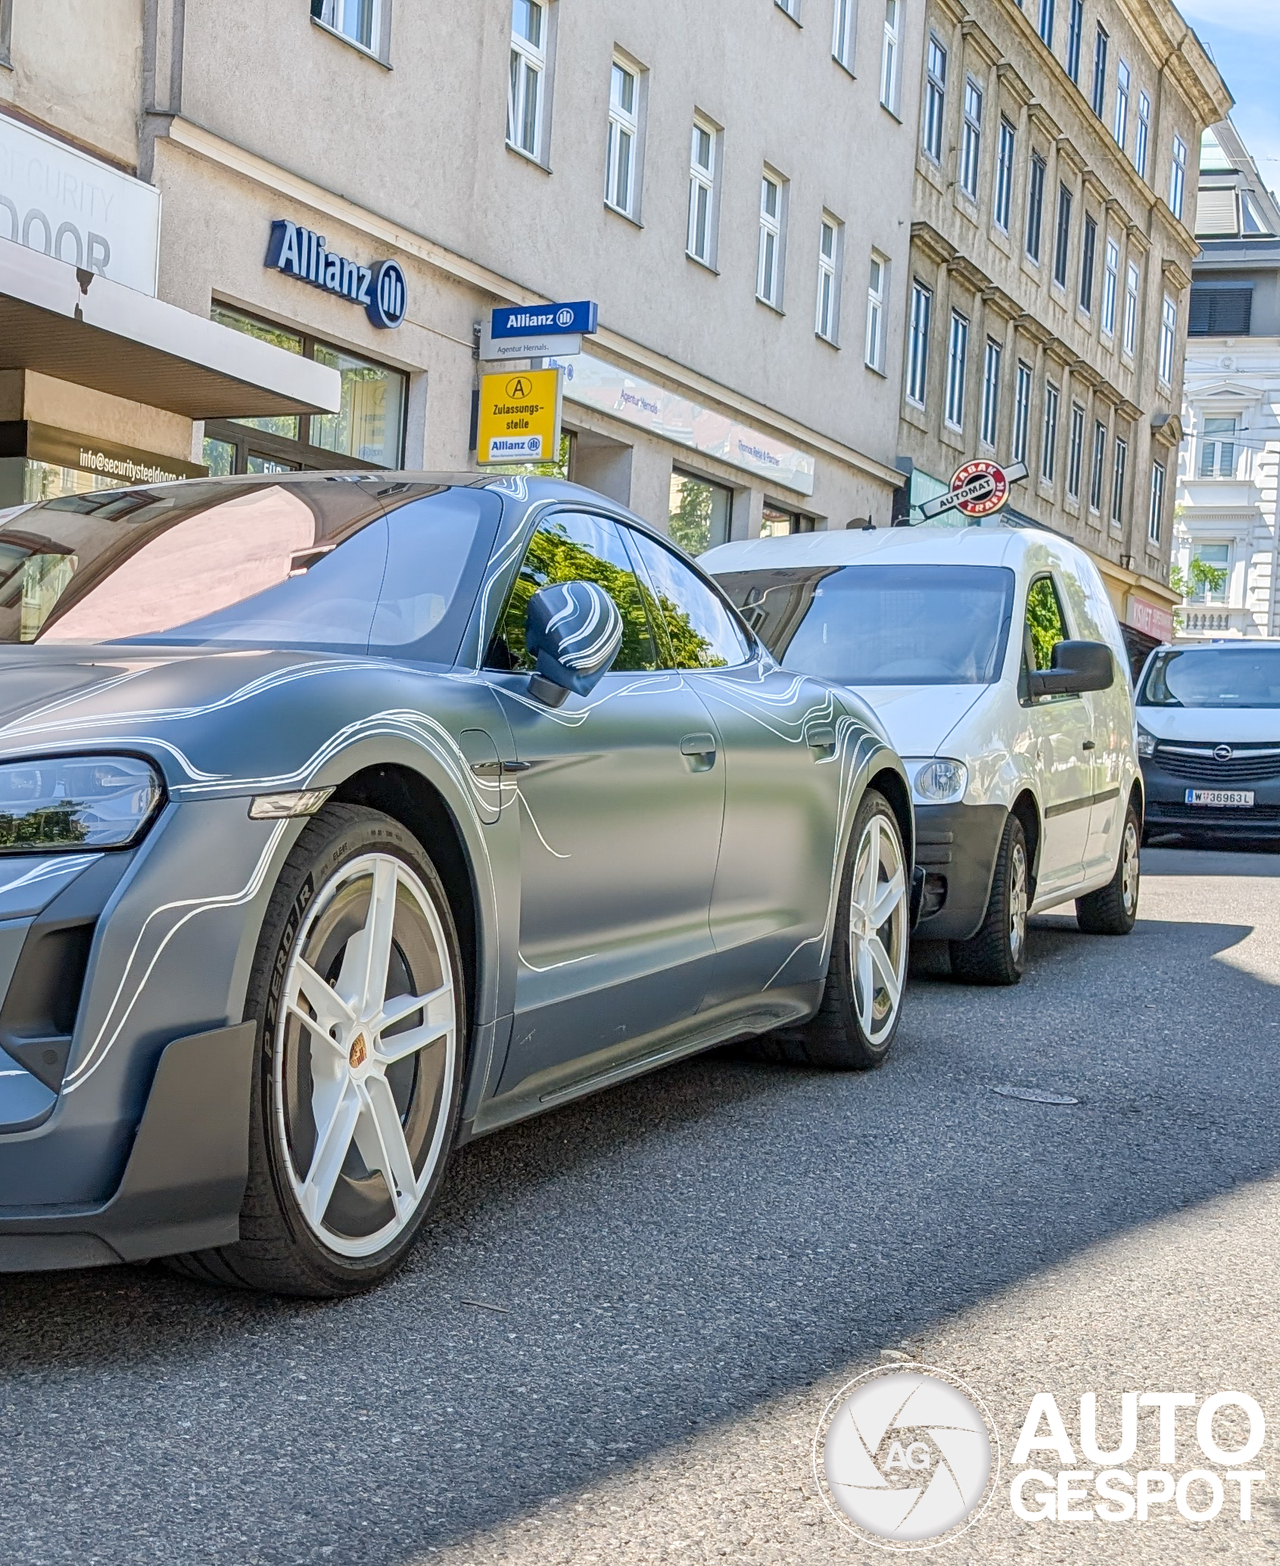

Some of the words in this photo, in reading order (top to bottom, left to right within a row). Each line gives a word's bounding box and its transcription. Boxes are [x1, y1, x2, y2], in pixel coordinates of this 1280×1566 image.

[277, 219, 372, 305] Allianz
[506, 314, 554, 328] Allianz
[497, 345, 522, 355] Agentur
[512, 379, 525, 397] A
[493, 404, 544, 415] Zulassungs-
[506, 418, 529, 430] stelle
[491, 440, 525, 451] Allianz
[954, 463, 997, 487] TABAK
[939, 479, 991, 508] AUTOMAT
[966, 481, 1005, 512] TRAFIK
[1194, 792, 1202, 802] W
[1209, 792, 1242, 803] 36963
[1243, 793, 1249, 803] L
[267, 923, 294, 1026] ZERO
[264, 1031, 272, 1059] P
